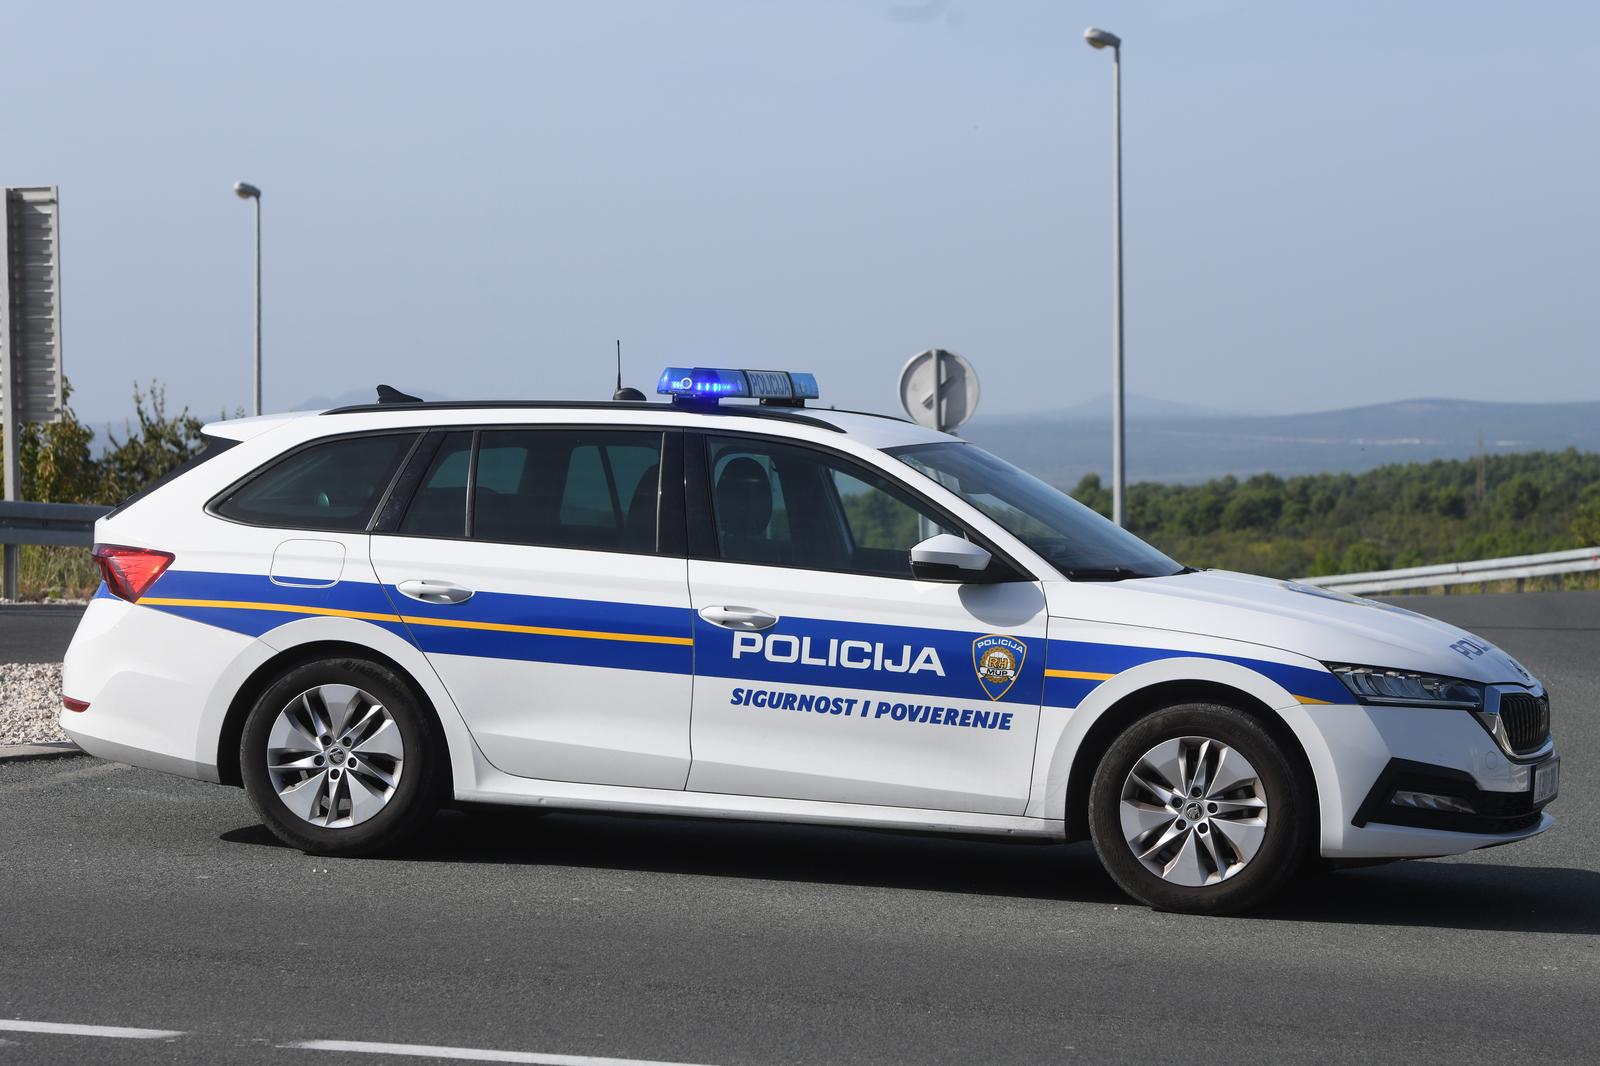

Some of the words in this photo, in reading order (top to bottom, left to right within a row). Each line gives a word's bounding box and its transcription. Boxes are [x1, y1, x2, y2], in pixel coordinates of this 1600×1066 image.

[750, 372, 791, 395] POLICIJA
[731, 631, 946, 676] POLICIJA
[977, 638, 1024, 654] POLICIJA
[988, 656, 1009, 668] RH
[986, 669, 1008, 677] MUP
[730, 687, 858, 717] SIGURNOST
[860, 699, 871, 718] I
[874, 701, 1014, 731] POVJERENJE
